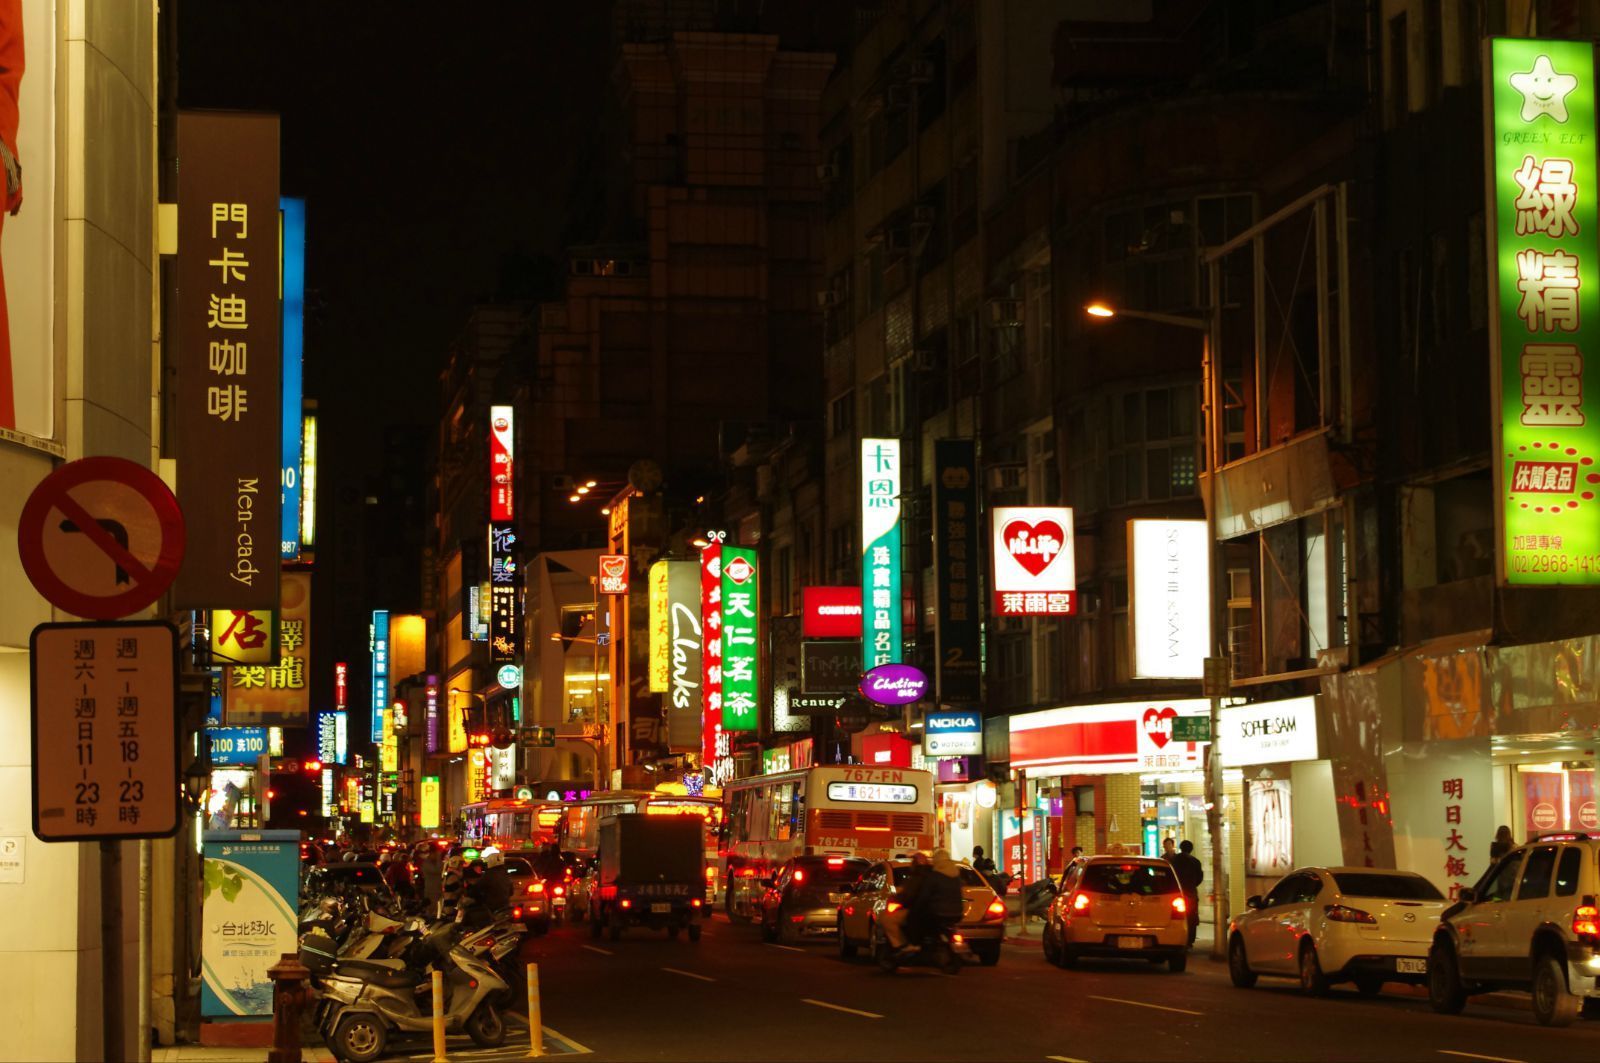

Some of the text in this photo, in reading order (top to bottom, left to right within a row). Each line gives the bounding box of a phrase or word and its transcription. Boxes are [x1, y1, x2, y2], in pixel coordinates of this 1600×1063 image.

[1503, 131, 1588, 146] GREEN ELF
[1515, 155, 1586, 427] 綠精靈
[207, 202, 249, 422] 門卡迪咖啡
[867, 444, 895, 508] 卡恩
[1515, 465, 1573, 490] 休閒食品
[231, 477, 259, 587] Men-cady
[1513, 535, 1563, 550] 加盟專線
[1009, 530, 1061, 563] Hi-Life
[1002, 592, 1070, 613] 萊爾富
[671, 602, 702, 709] Clarks
[722, 592, 756, 717] 天仁茗茶
[873, 677, 924, 690] Chatime
[929, 718, 976, 729] NOKIA
[843, 769, 903, 783] 767-FN
[896, 837, 916, 848] 621
